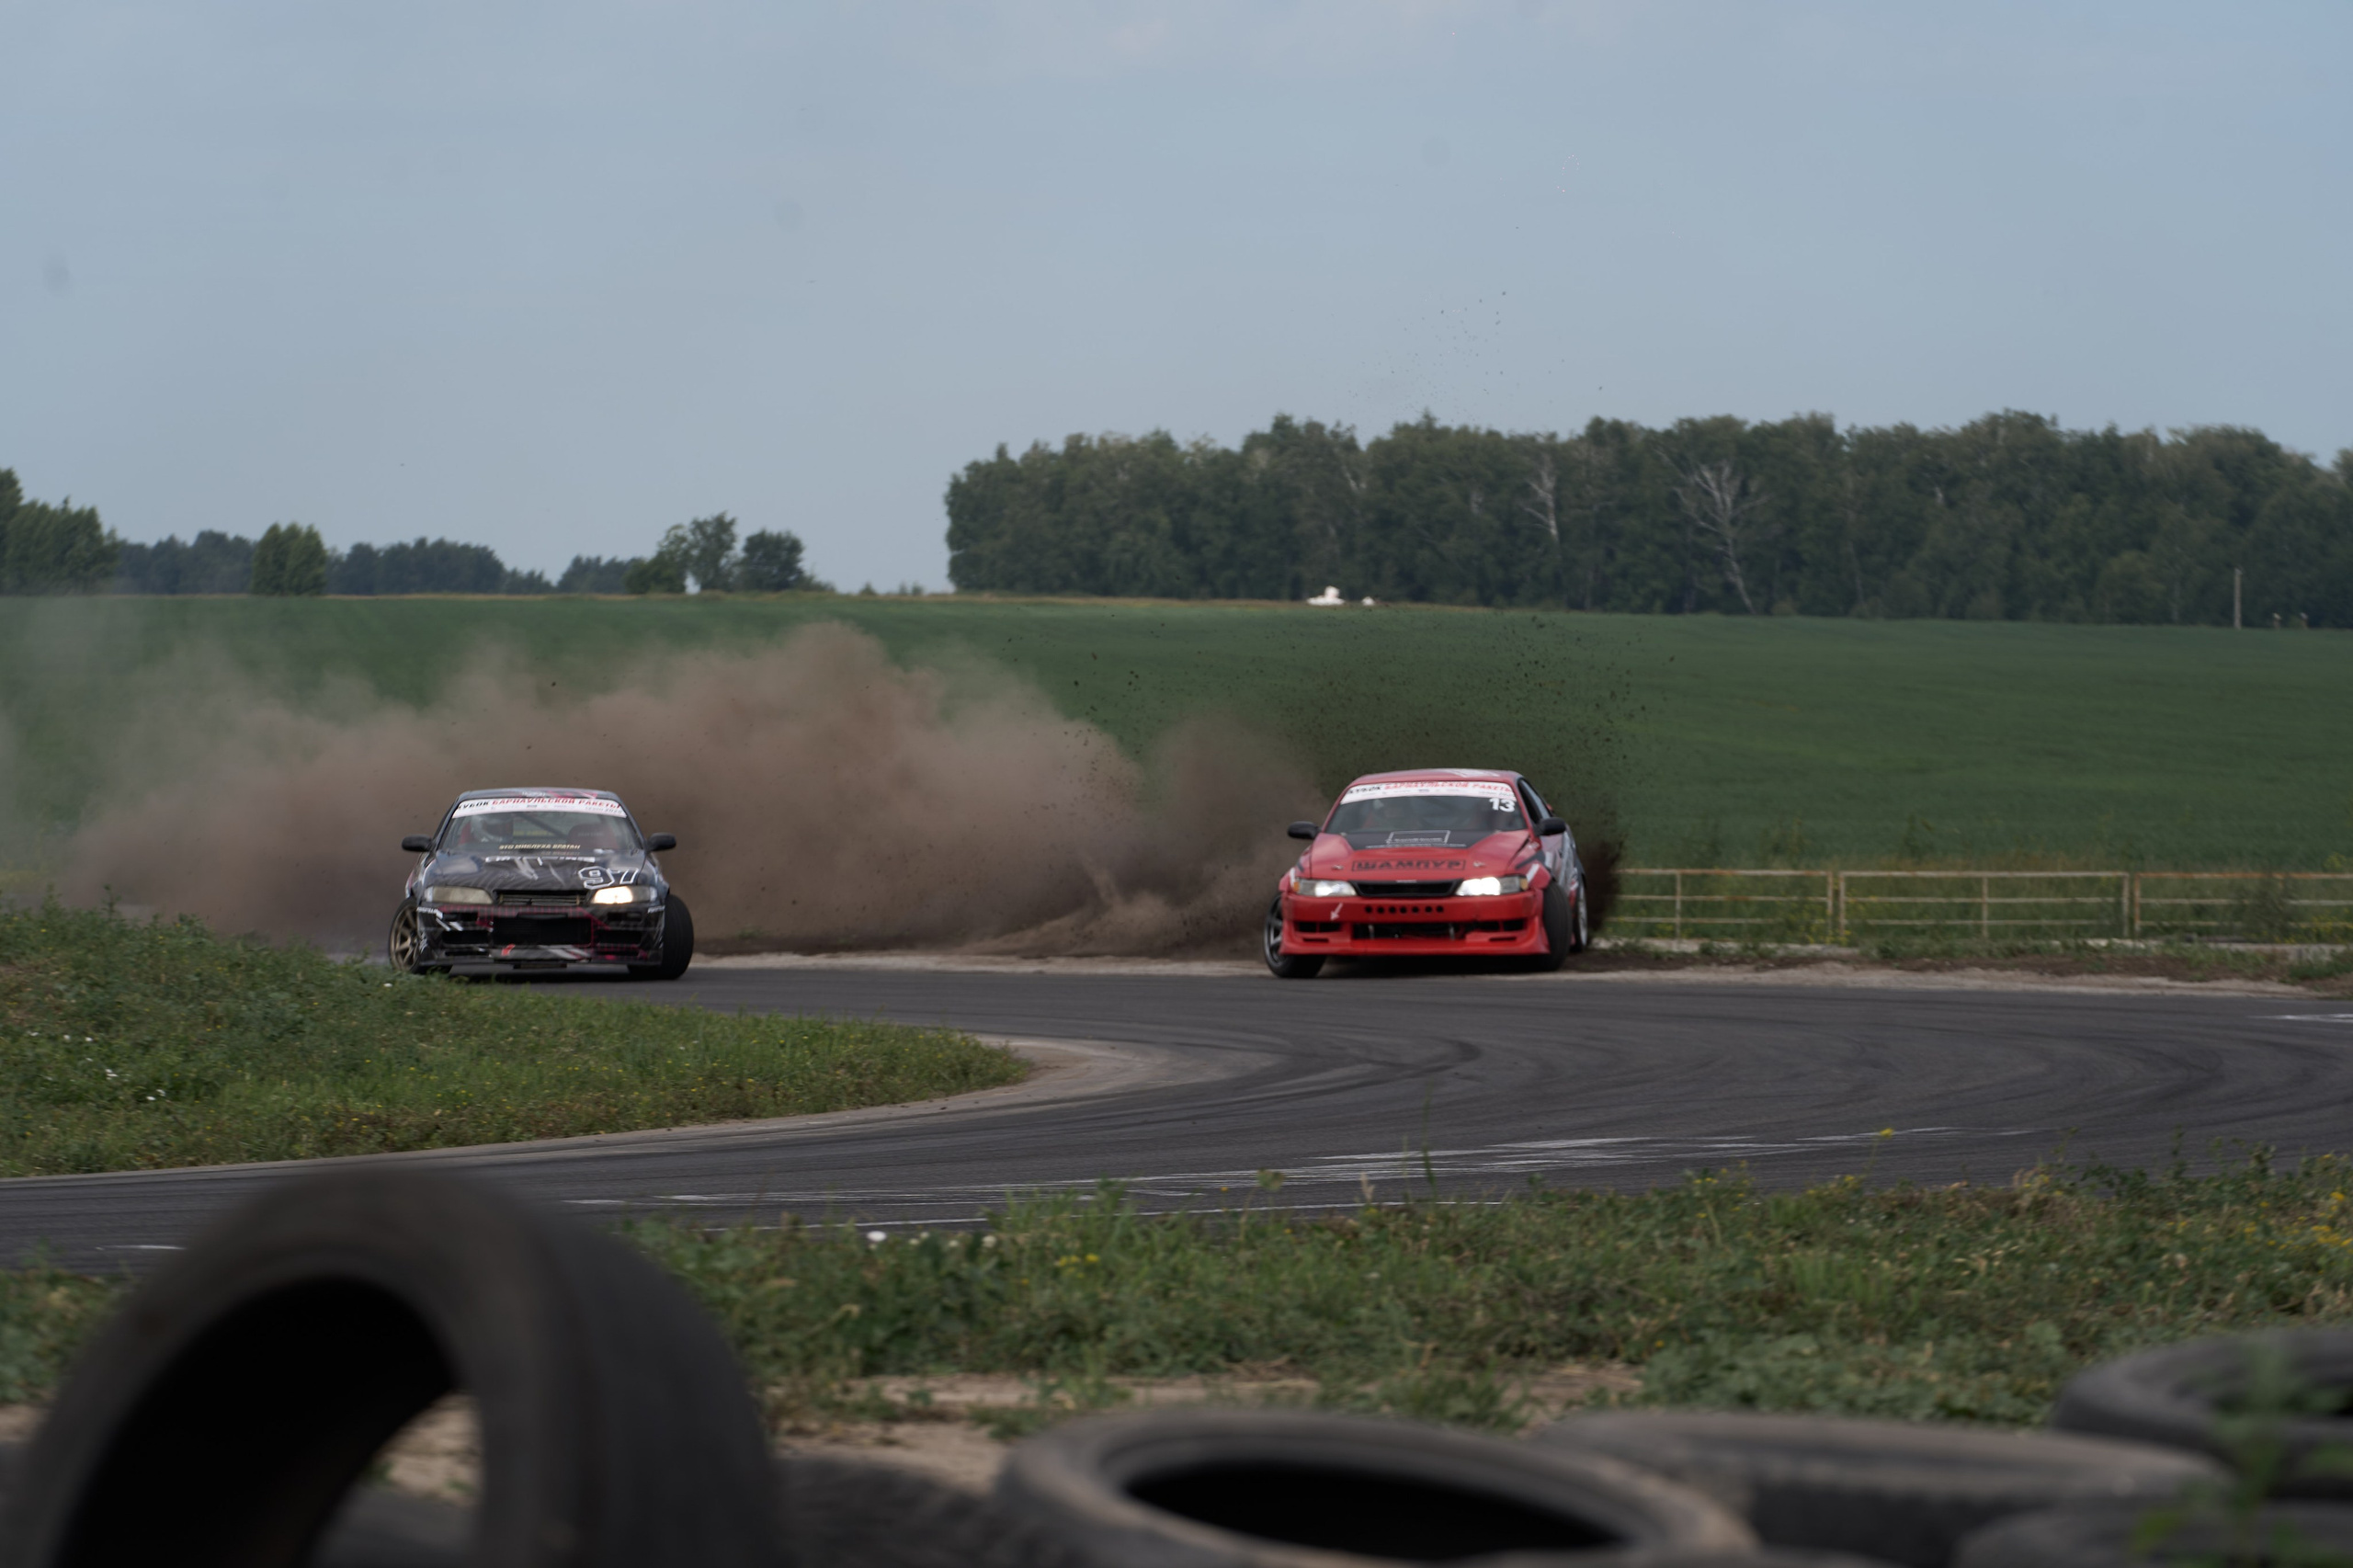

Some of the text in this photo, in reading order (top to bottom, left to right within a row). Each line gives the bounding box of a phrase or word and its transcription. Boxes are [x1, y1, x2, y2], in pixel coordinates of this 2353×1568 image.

[1489, 798, 1516, 812] 13
[1357, 860, 1461, 870] ШАМПУР
[578, 866, 640, 890] 97
